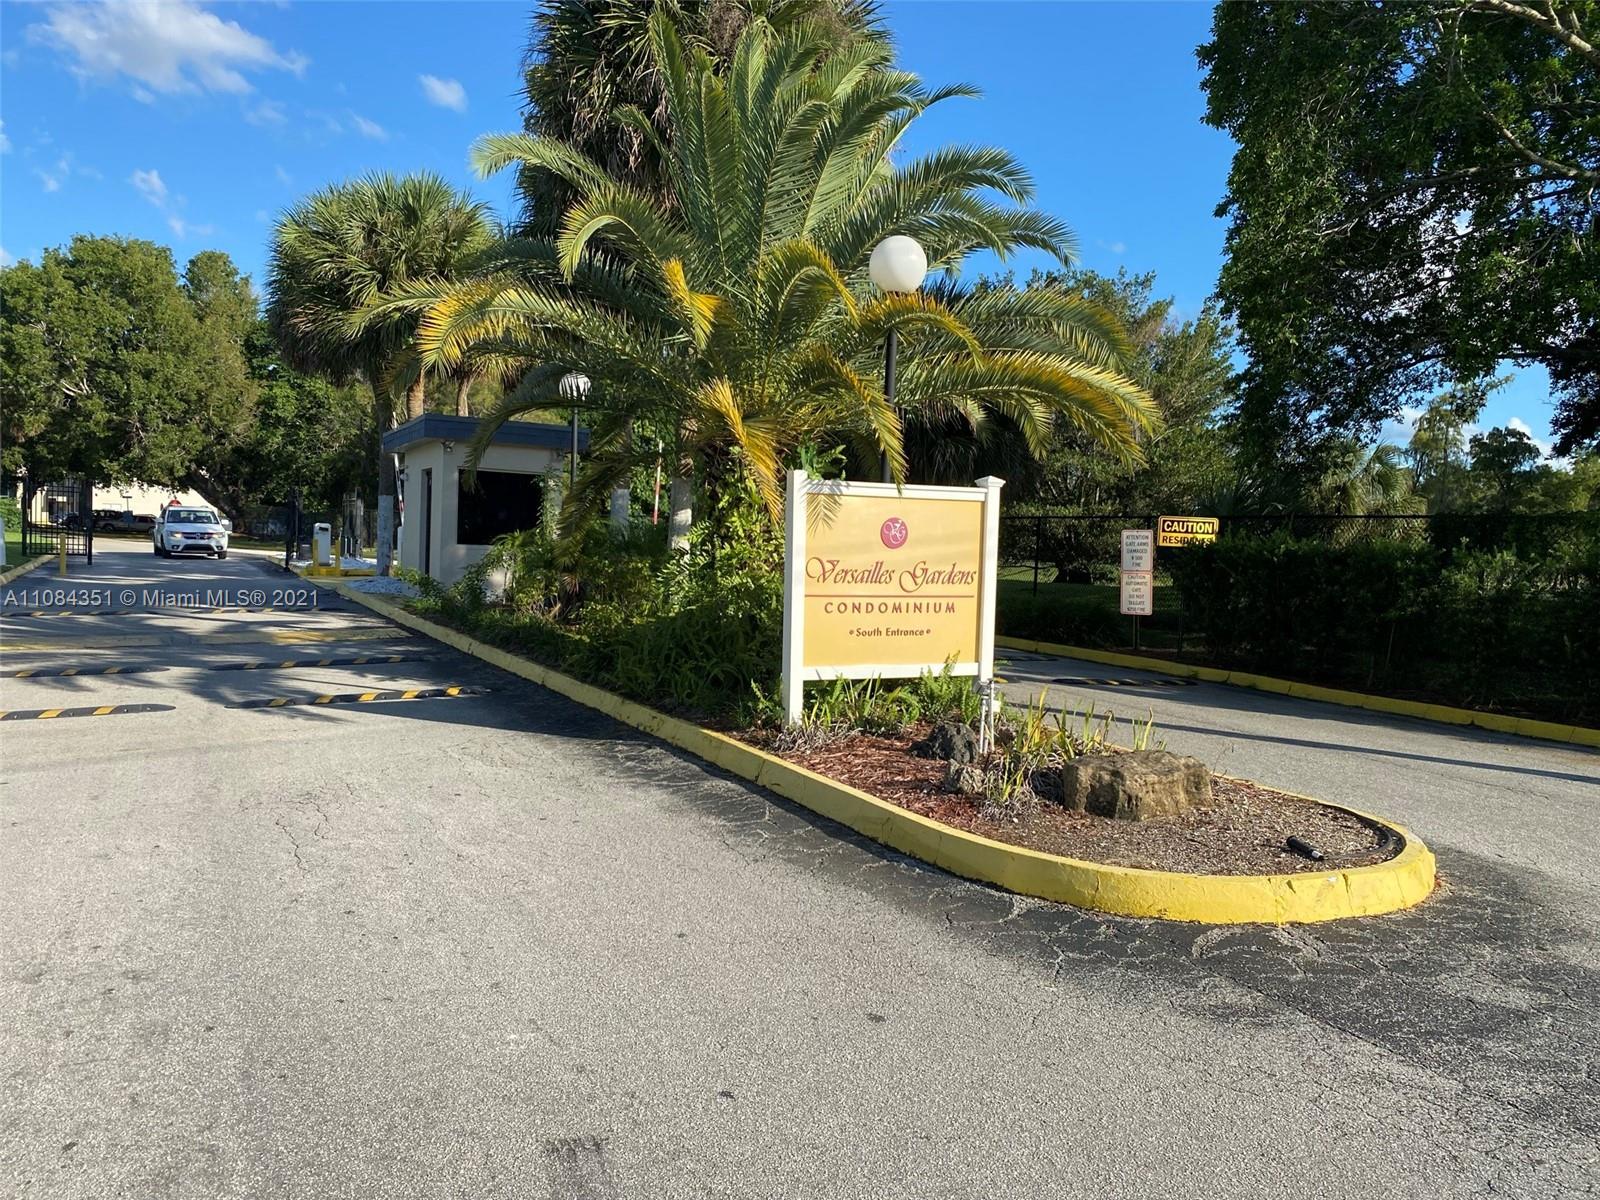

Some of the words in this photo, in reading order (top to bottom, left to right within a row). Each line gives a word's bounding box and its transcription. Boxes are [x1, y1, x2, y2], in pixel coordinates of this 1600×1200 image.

[1164, 521, 1212, 533] CAUTION
[806, 557, 895, 585] Versailles
[899, 561, 977, 593] Gardens
[824, 602, 956, 614] CONDOMINIUM
[856, 627, 882, 636] South
[886, 628, 924, 636] Entrance
